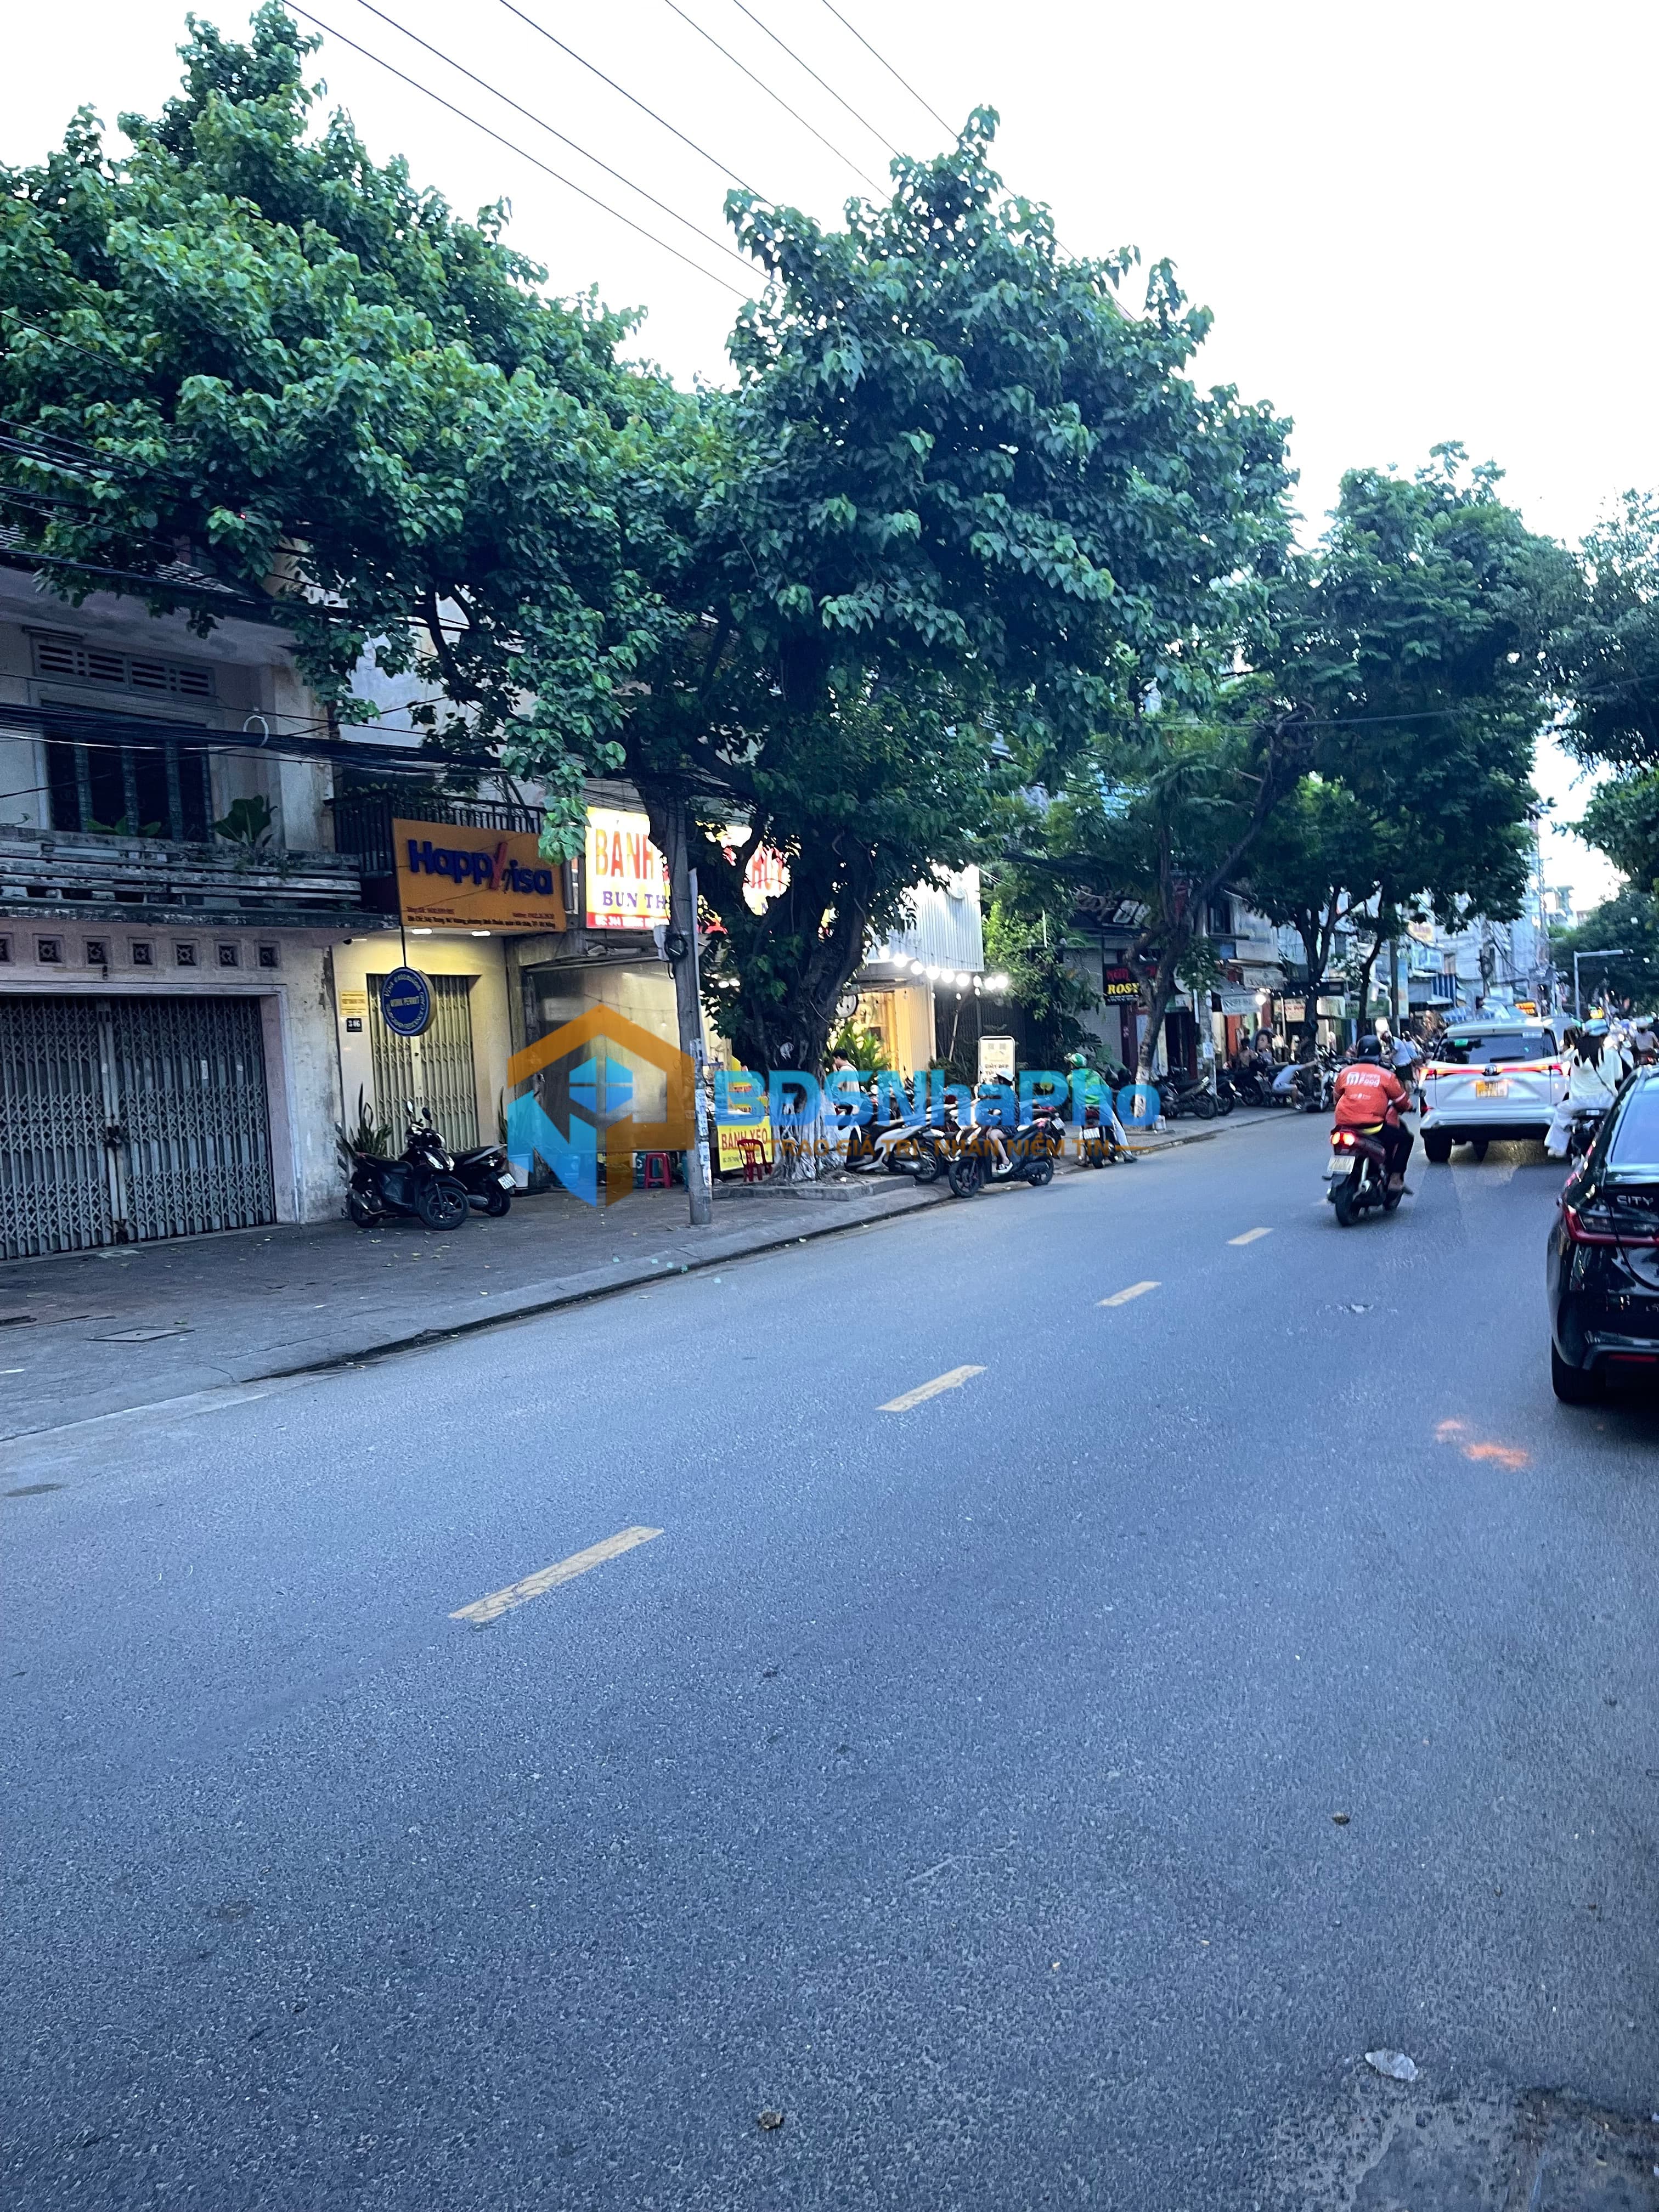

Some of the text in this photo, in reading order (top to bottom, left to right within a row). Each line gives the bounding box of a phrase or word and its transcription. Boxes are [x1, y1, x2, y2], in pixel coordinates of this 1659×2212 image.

[596, 820, 653, 879] BÁNH
[1107, 983, 1139, 995] ROSY
[1617, 1195, 1654, 1206] CITY
